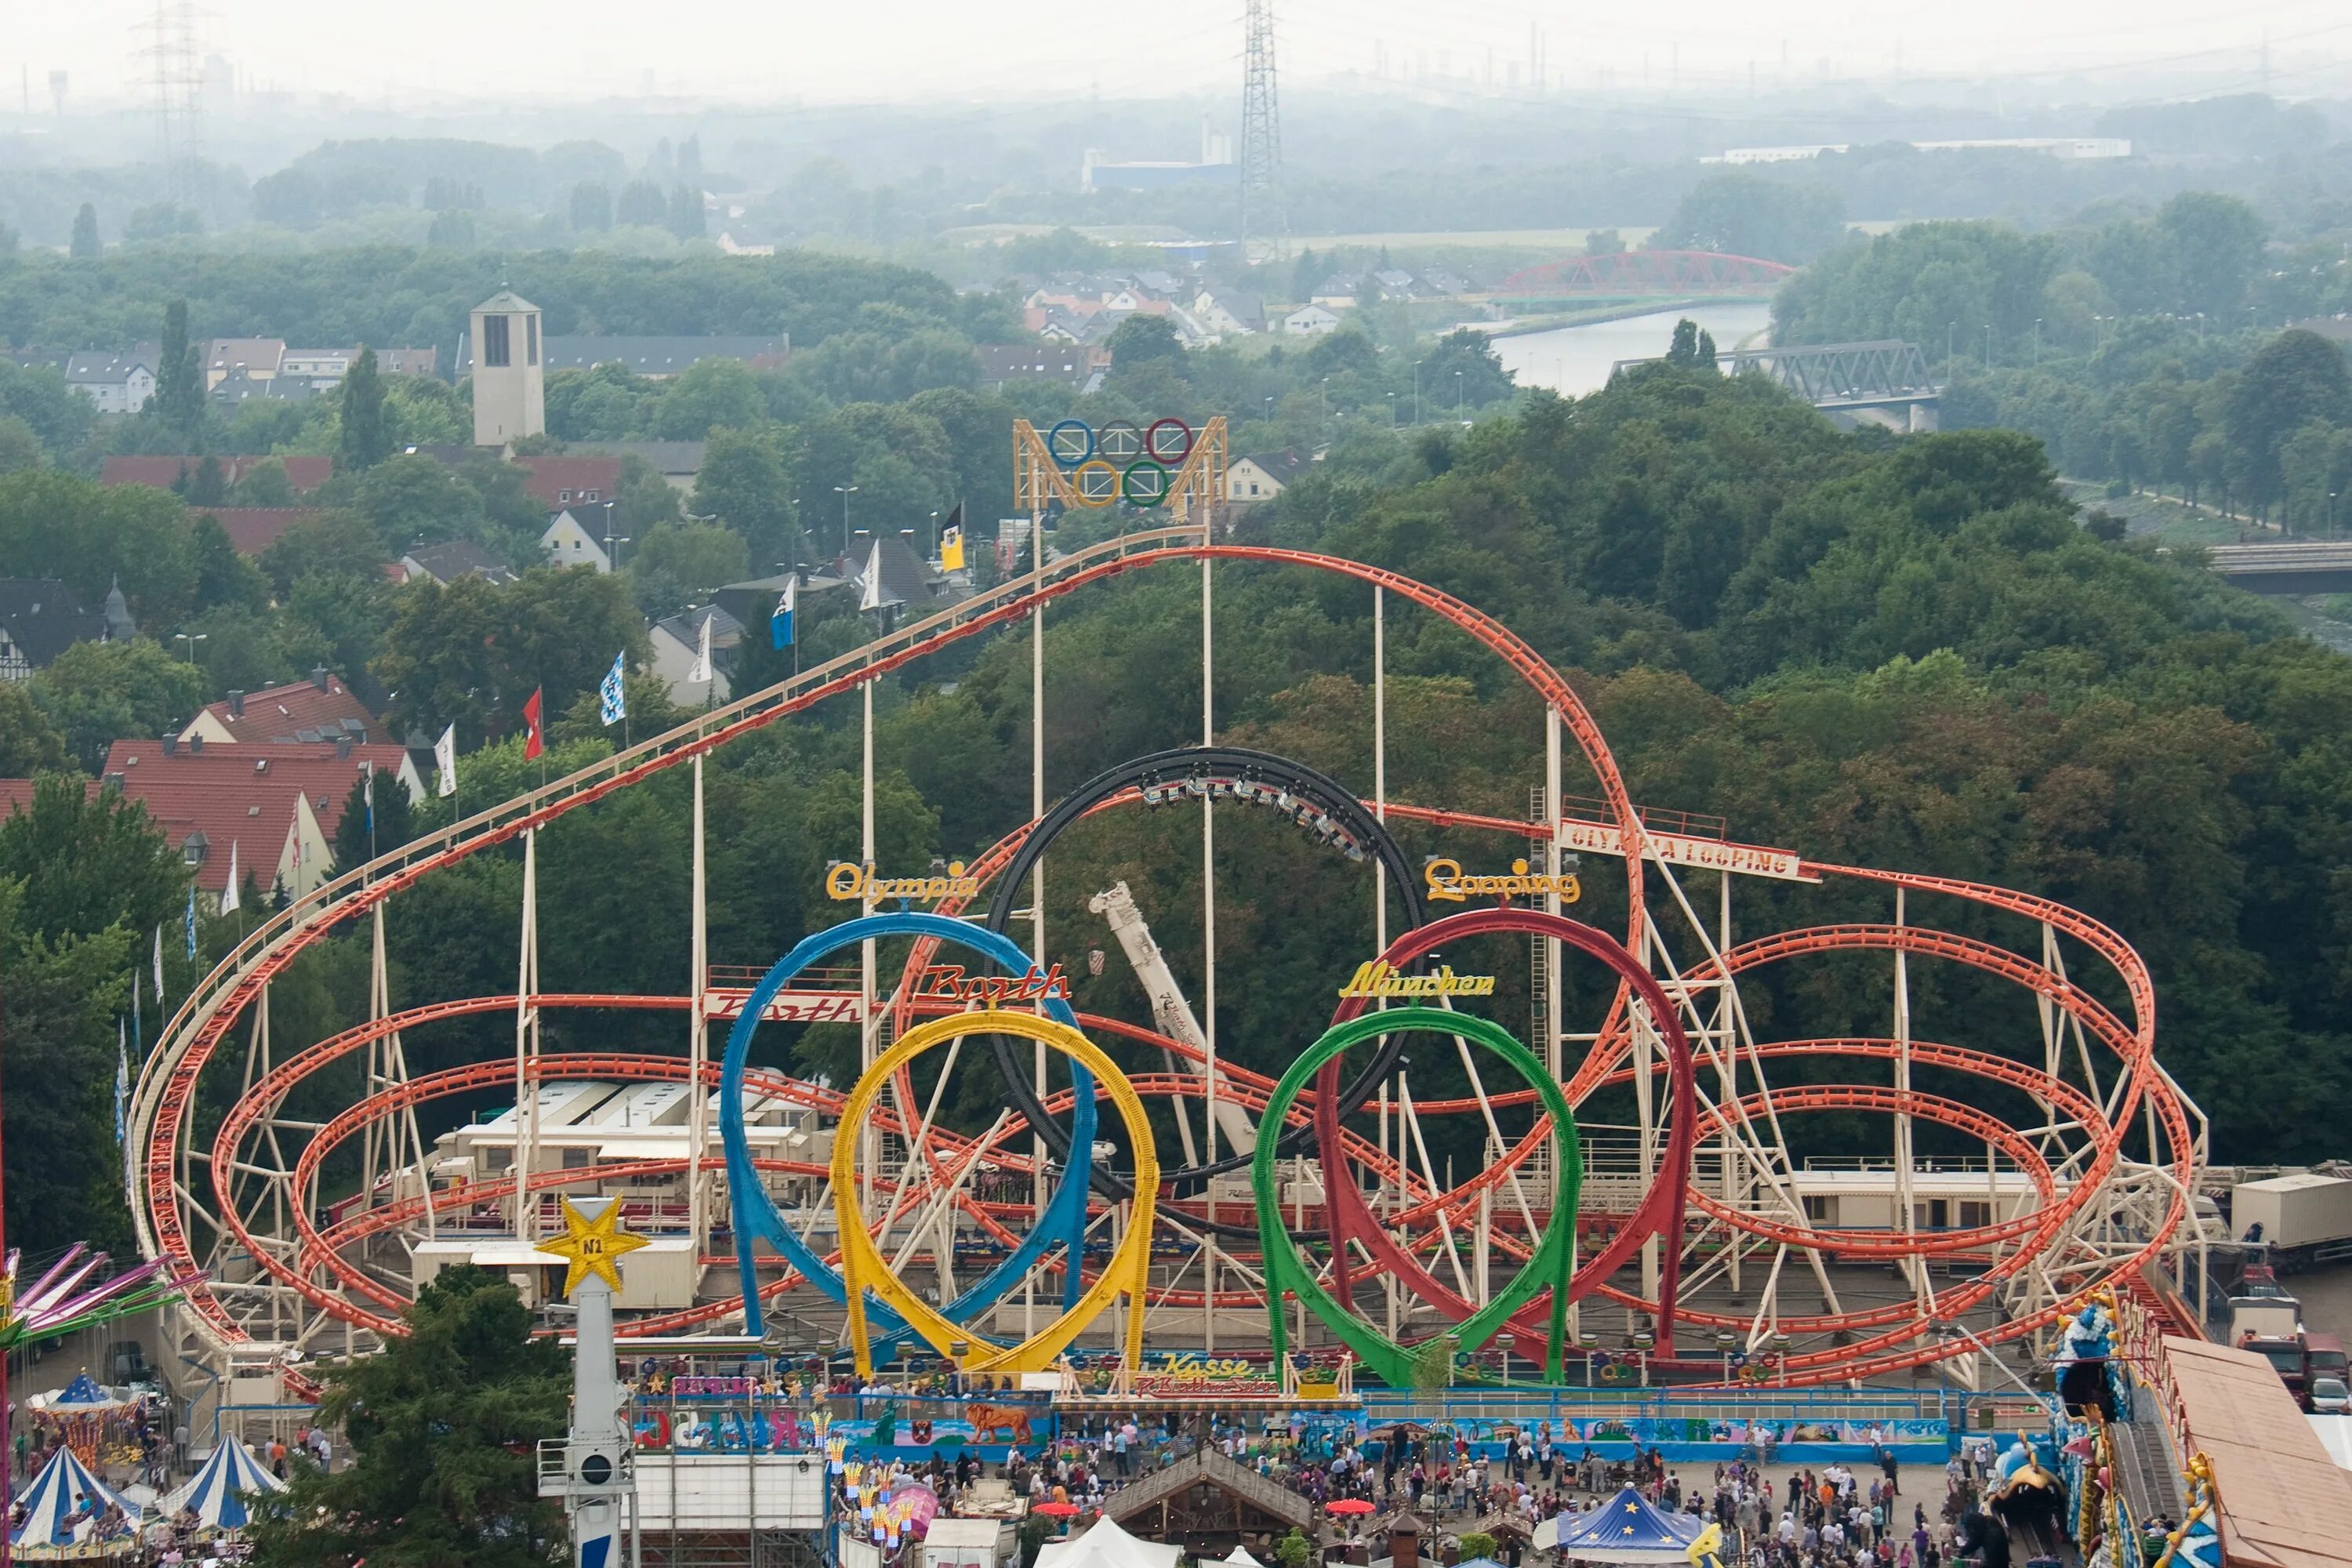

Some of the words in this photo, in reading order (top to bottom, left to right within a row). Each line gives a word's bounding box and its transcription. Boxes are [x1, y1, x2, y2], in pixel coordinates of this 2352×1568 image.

[1686, 843, 1788, 873] LOOPING
[826, 861, 979, 906] Olympia
[1425, 858, 1581, 903] Looping
[913, 964, 1073, 1003] Barth
[1338, 960, 1495, 998] München
[583, 1239, 603, 1254] N1
[1157, 1352, 1256, 1378] Kasse
